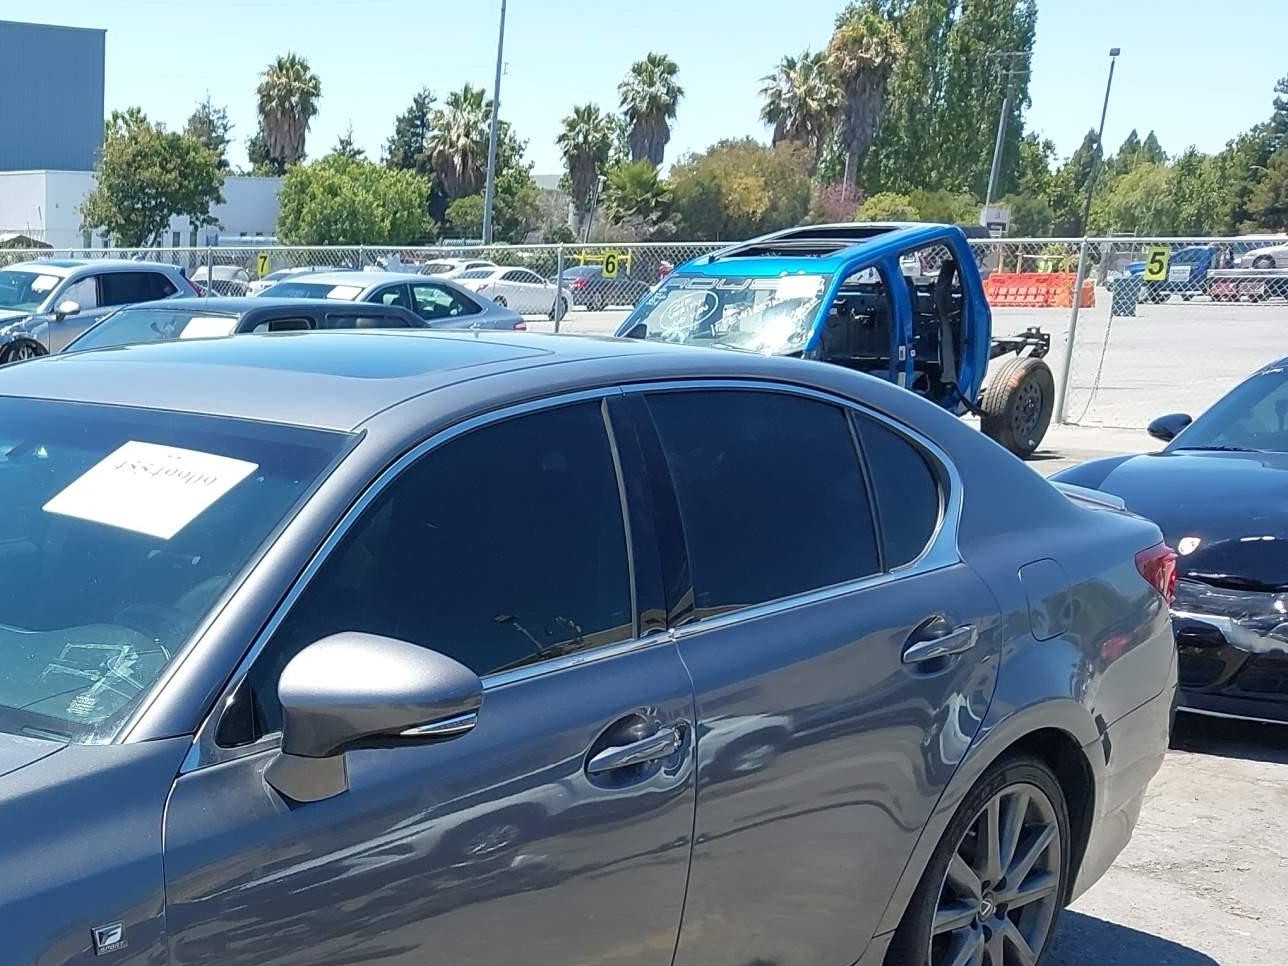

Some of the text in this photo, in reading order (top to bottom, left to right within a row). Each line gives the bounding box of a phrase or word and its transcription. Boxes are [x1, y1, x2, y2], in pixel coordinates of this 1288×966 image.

[259, 255, 268, 273] 7
[605, 254, 616, 274] 6
[1148, 251, 1166, 276] 5
